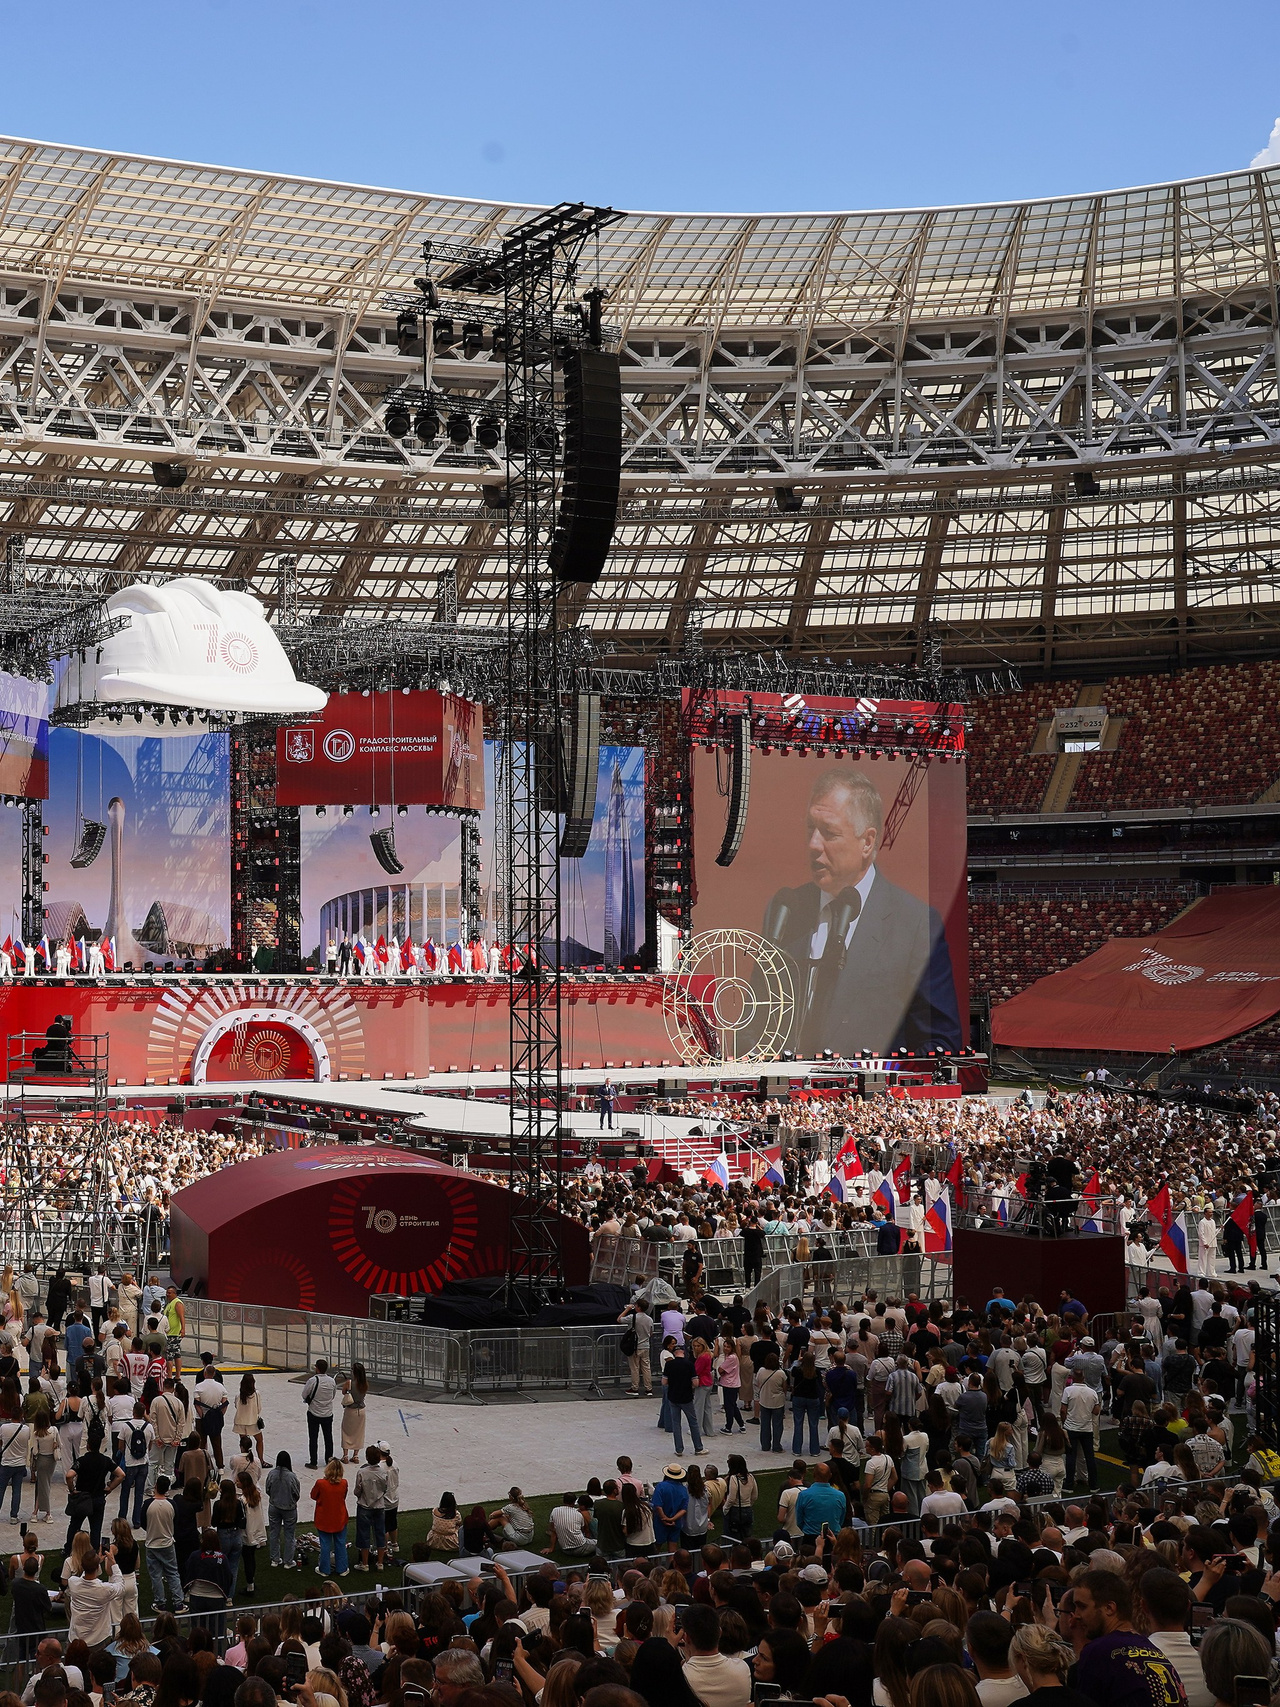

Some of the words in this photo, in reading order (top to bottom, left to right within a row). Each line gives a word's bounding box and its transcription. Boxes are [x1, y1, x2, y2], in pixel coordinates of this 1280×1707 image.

[359, 735, 438, 744] ГРАДОСТРОИТЕЛЬНЫЙ
[359, 745, 399, 753] КОМПЛЕКС
[361, 1206, 398, 1234] 70
[132, 1363, 146, 1377] 12
